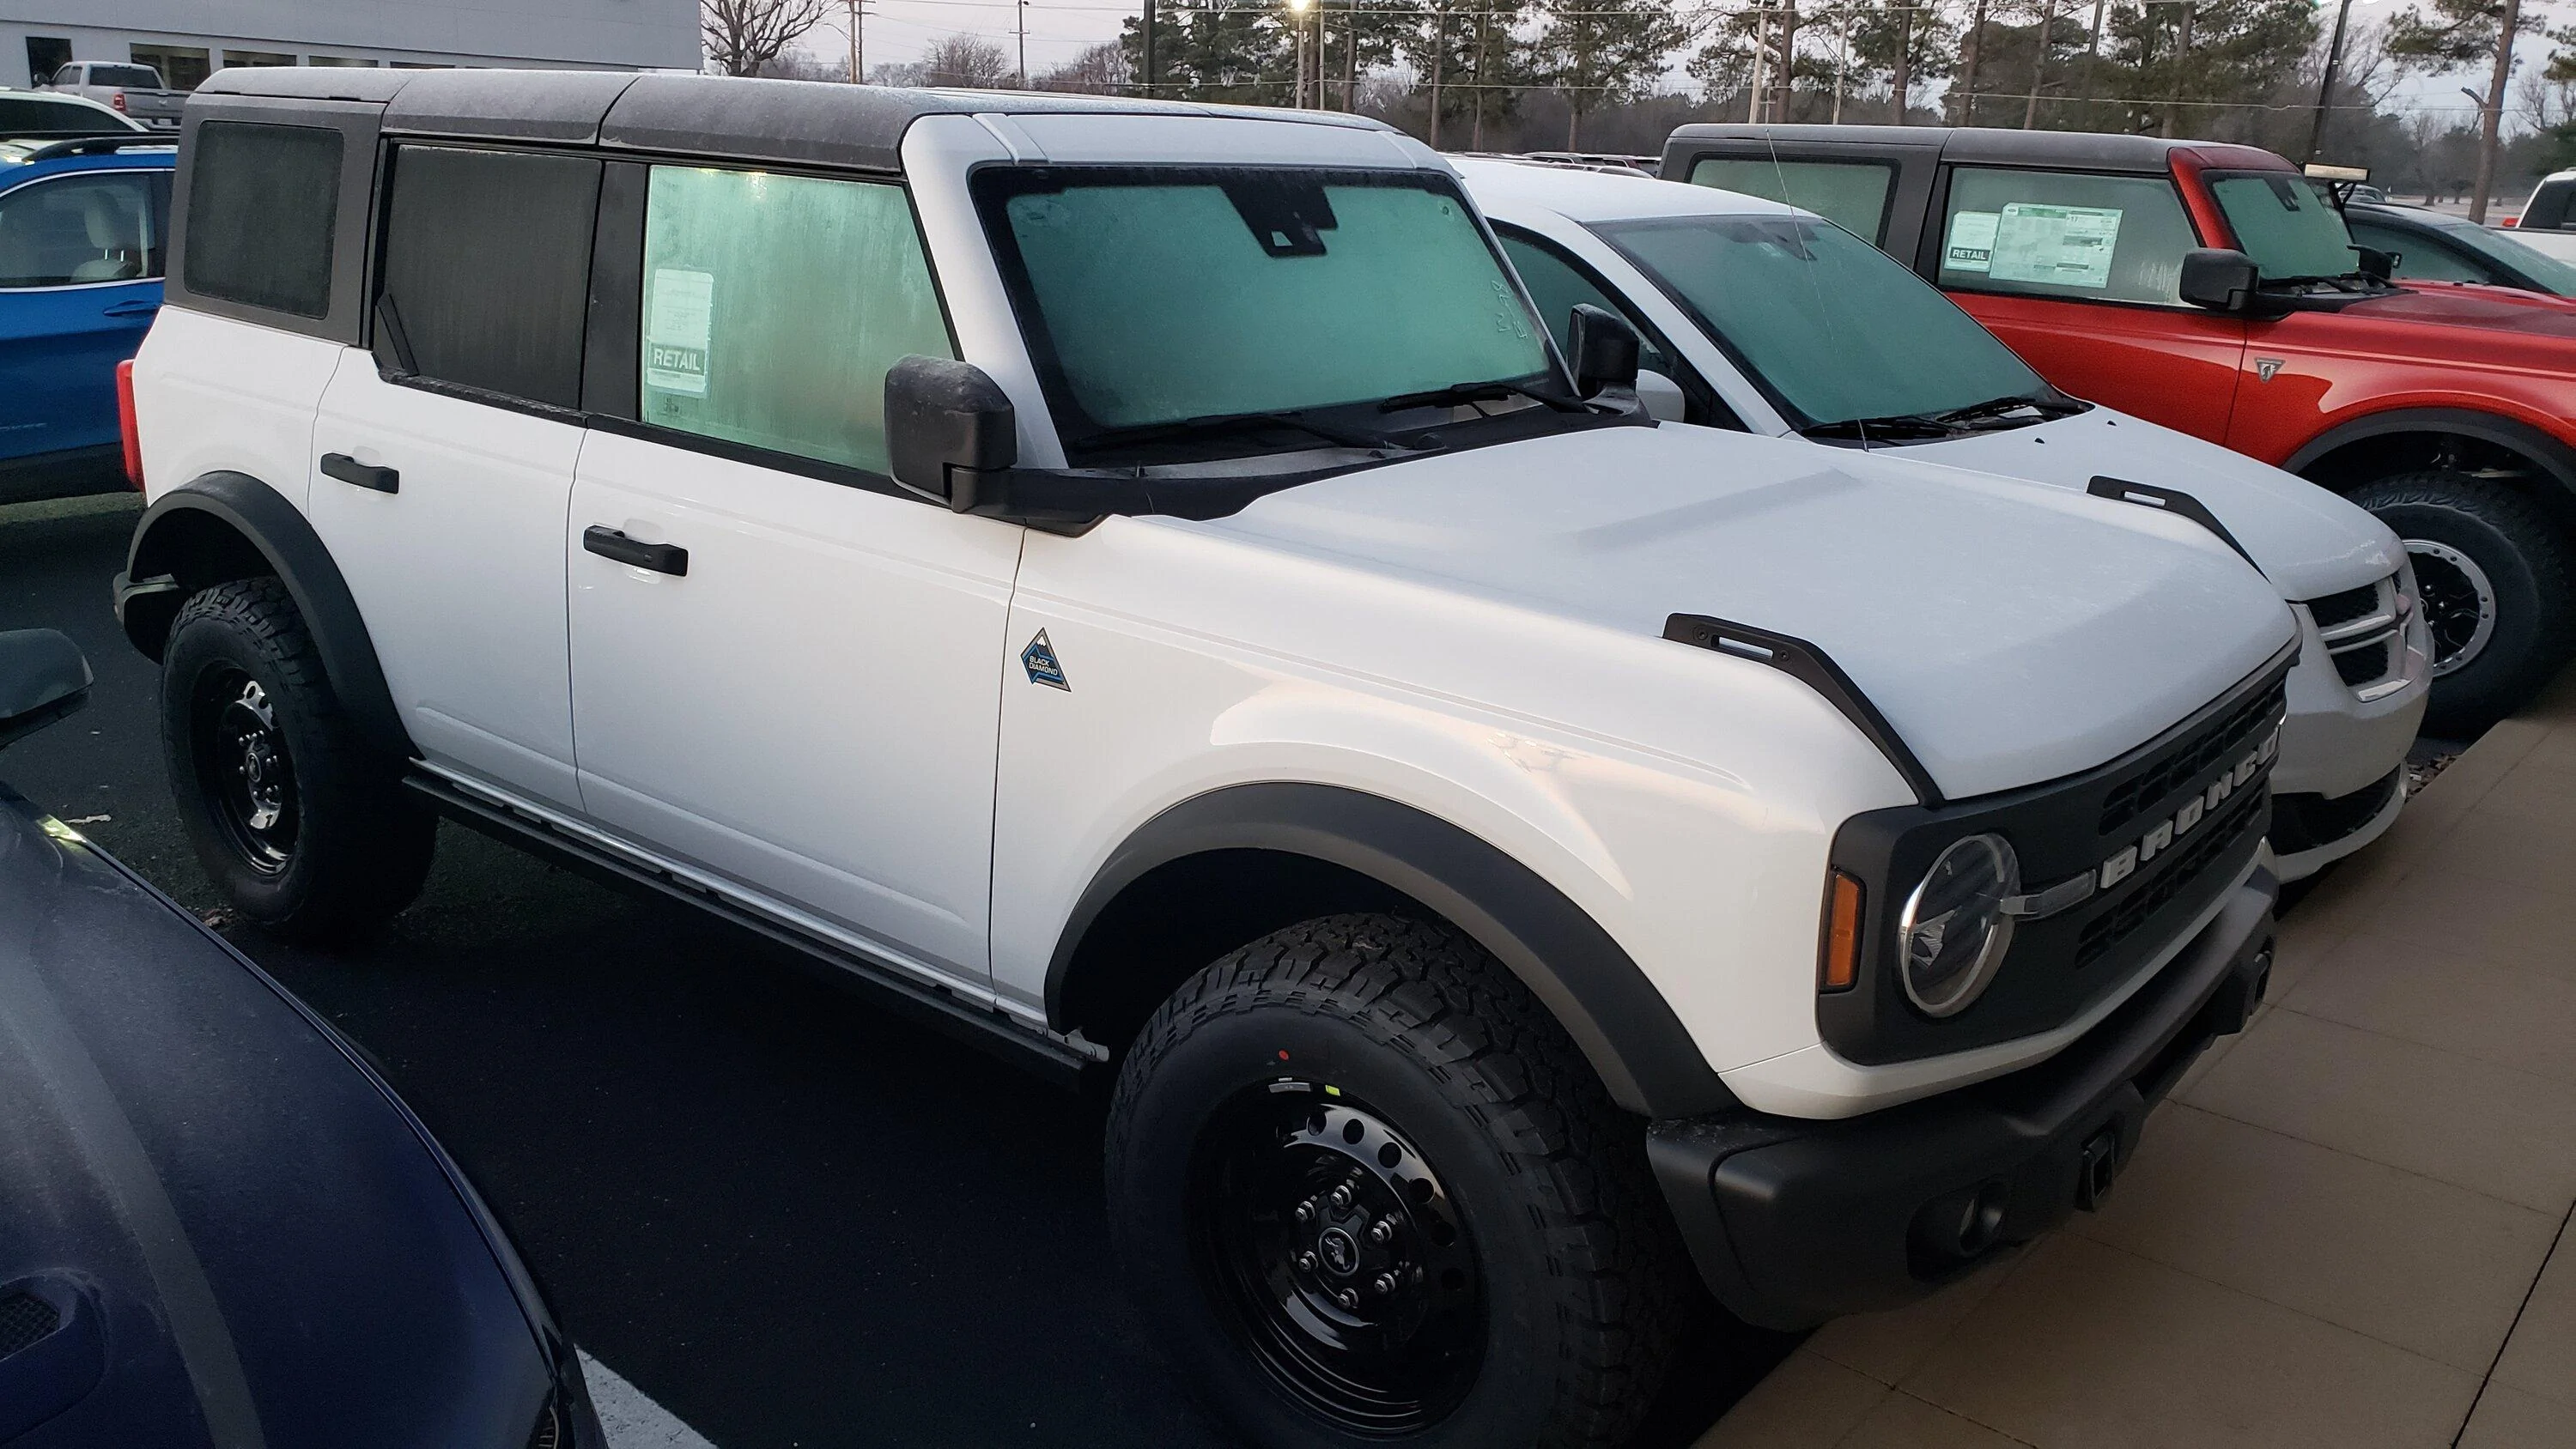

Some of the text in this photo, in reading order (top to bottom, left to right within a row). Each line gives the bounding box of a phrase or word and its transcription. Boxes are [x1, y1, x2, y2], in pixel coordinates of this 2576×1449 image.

[1952, 249, 1987, 260] RETAIL
[653, 348, 700, 371] RETAIL
[1029, 655, 1050, 667] BLACK
[1029, 662, 1058, 676] DIAMOND
[2100, 725, 2279, 888] BRONCO
